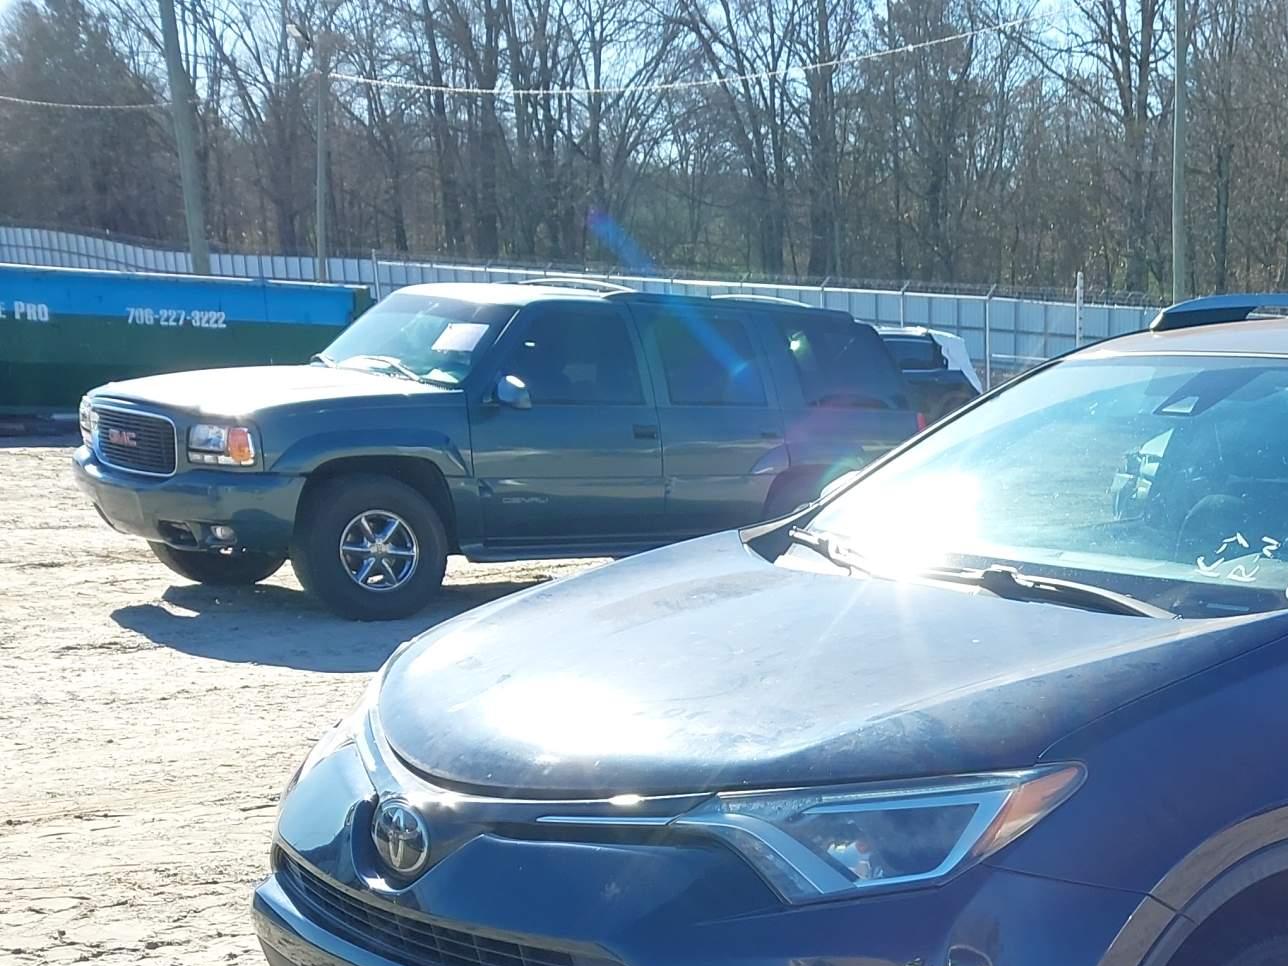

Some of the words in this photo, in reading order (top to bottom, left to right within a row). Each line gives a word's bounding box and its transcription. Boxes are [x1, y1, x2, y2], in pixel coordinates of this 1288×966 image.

[14, 300, 49, 321] PRO
[108, 428, 136, 447] GMC
[501, 496, 549, 504] DENALI
